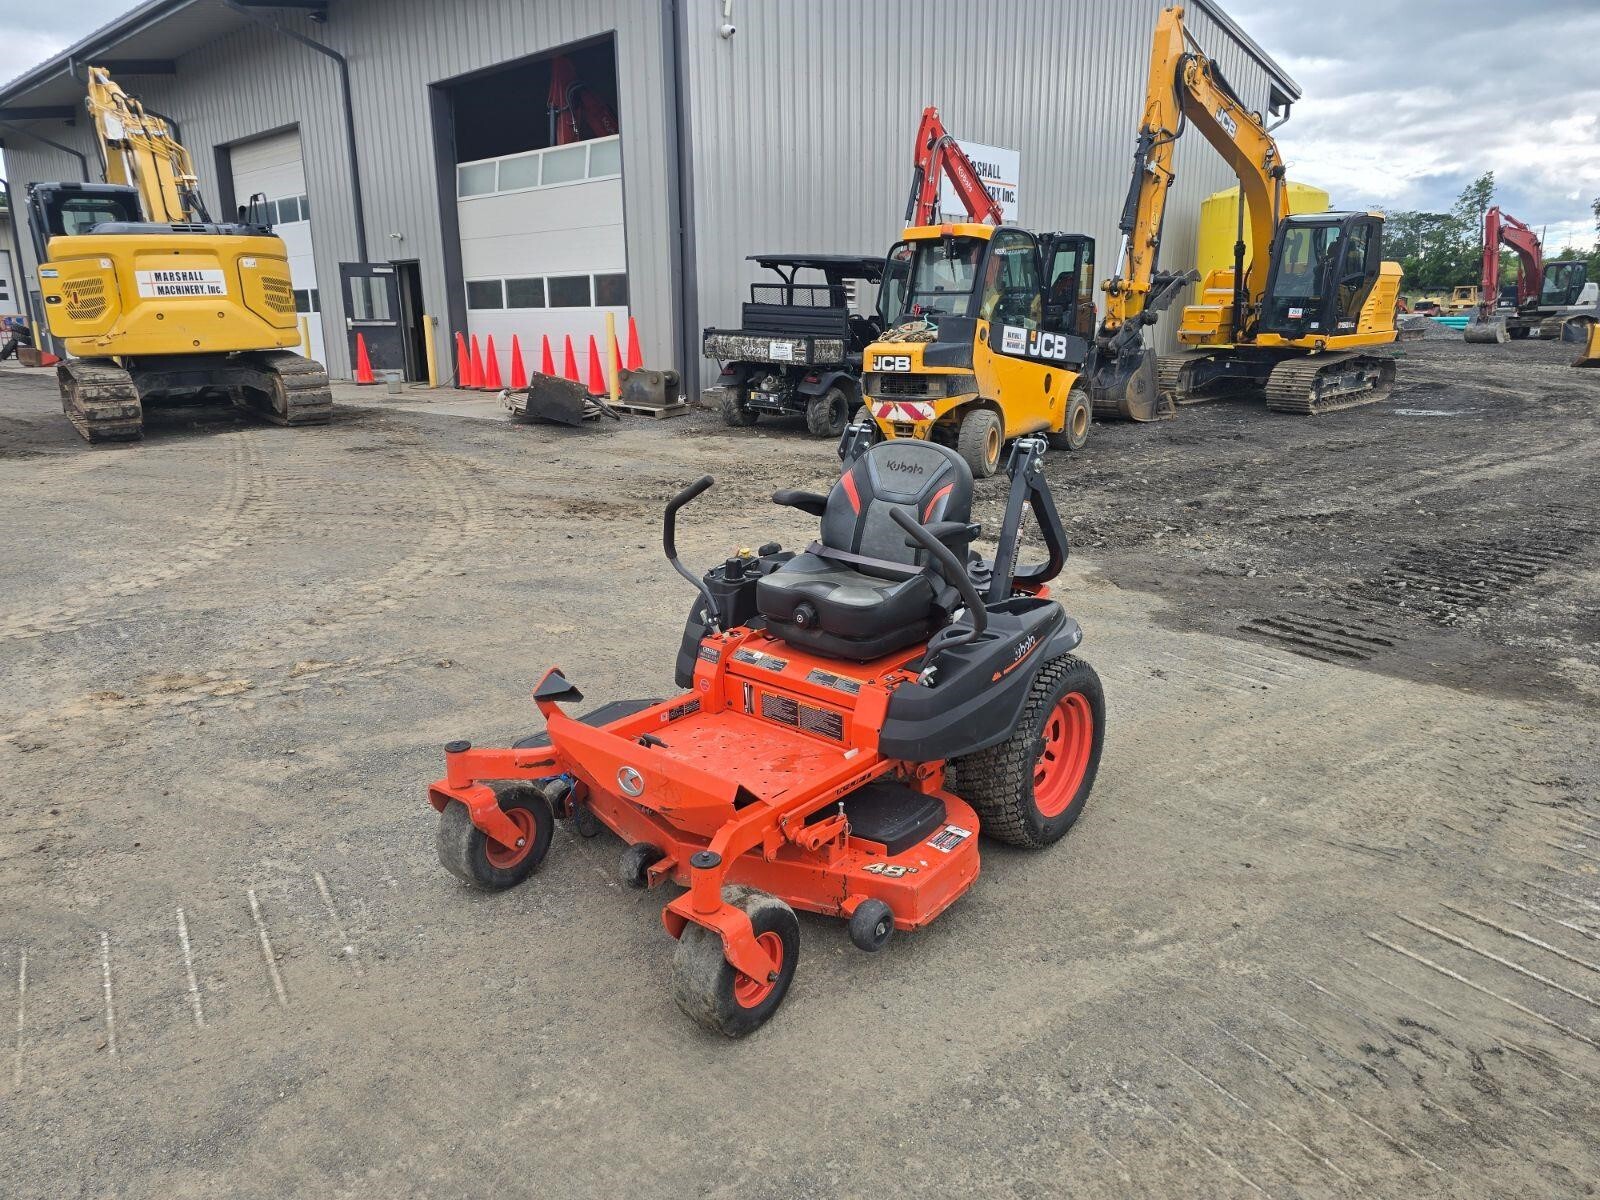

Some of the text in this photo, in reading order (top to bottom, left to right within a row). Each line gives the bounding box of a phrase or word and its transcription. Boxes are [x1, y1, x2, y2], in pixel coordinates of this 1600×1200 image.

[1216, 108, 1236, 138] JCB
[971, 160, 1002, 179] RSHALL
[957, 165, 973, 193] Kubota
[1002, 187, 1016, 203] Inc.
[154, 271, 204, 282] MARSHALL
[207, 284, 223, 294] Inc.
[1030, 331, 1067, 360] JCB
[873, 355, 911, 371] JCB
[886, 460, 924, 474] Kubota
